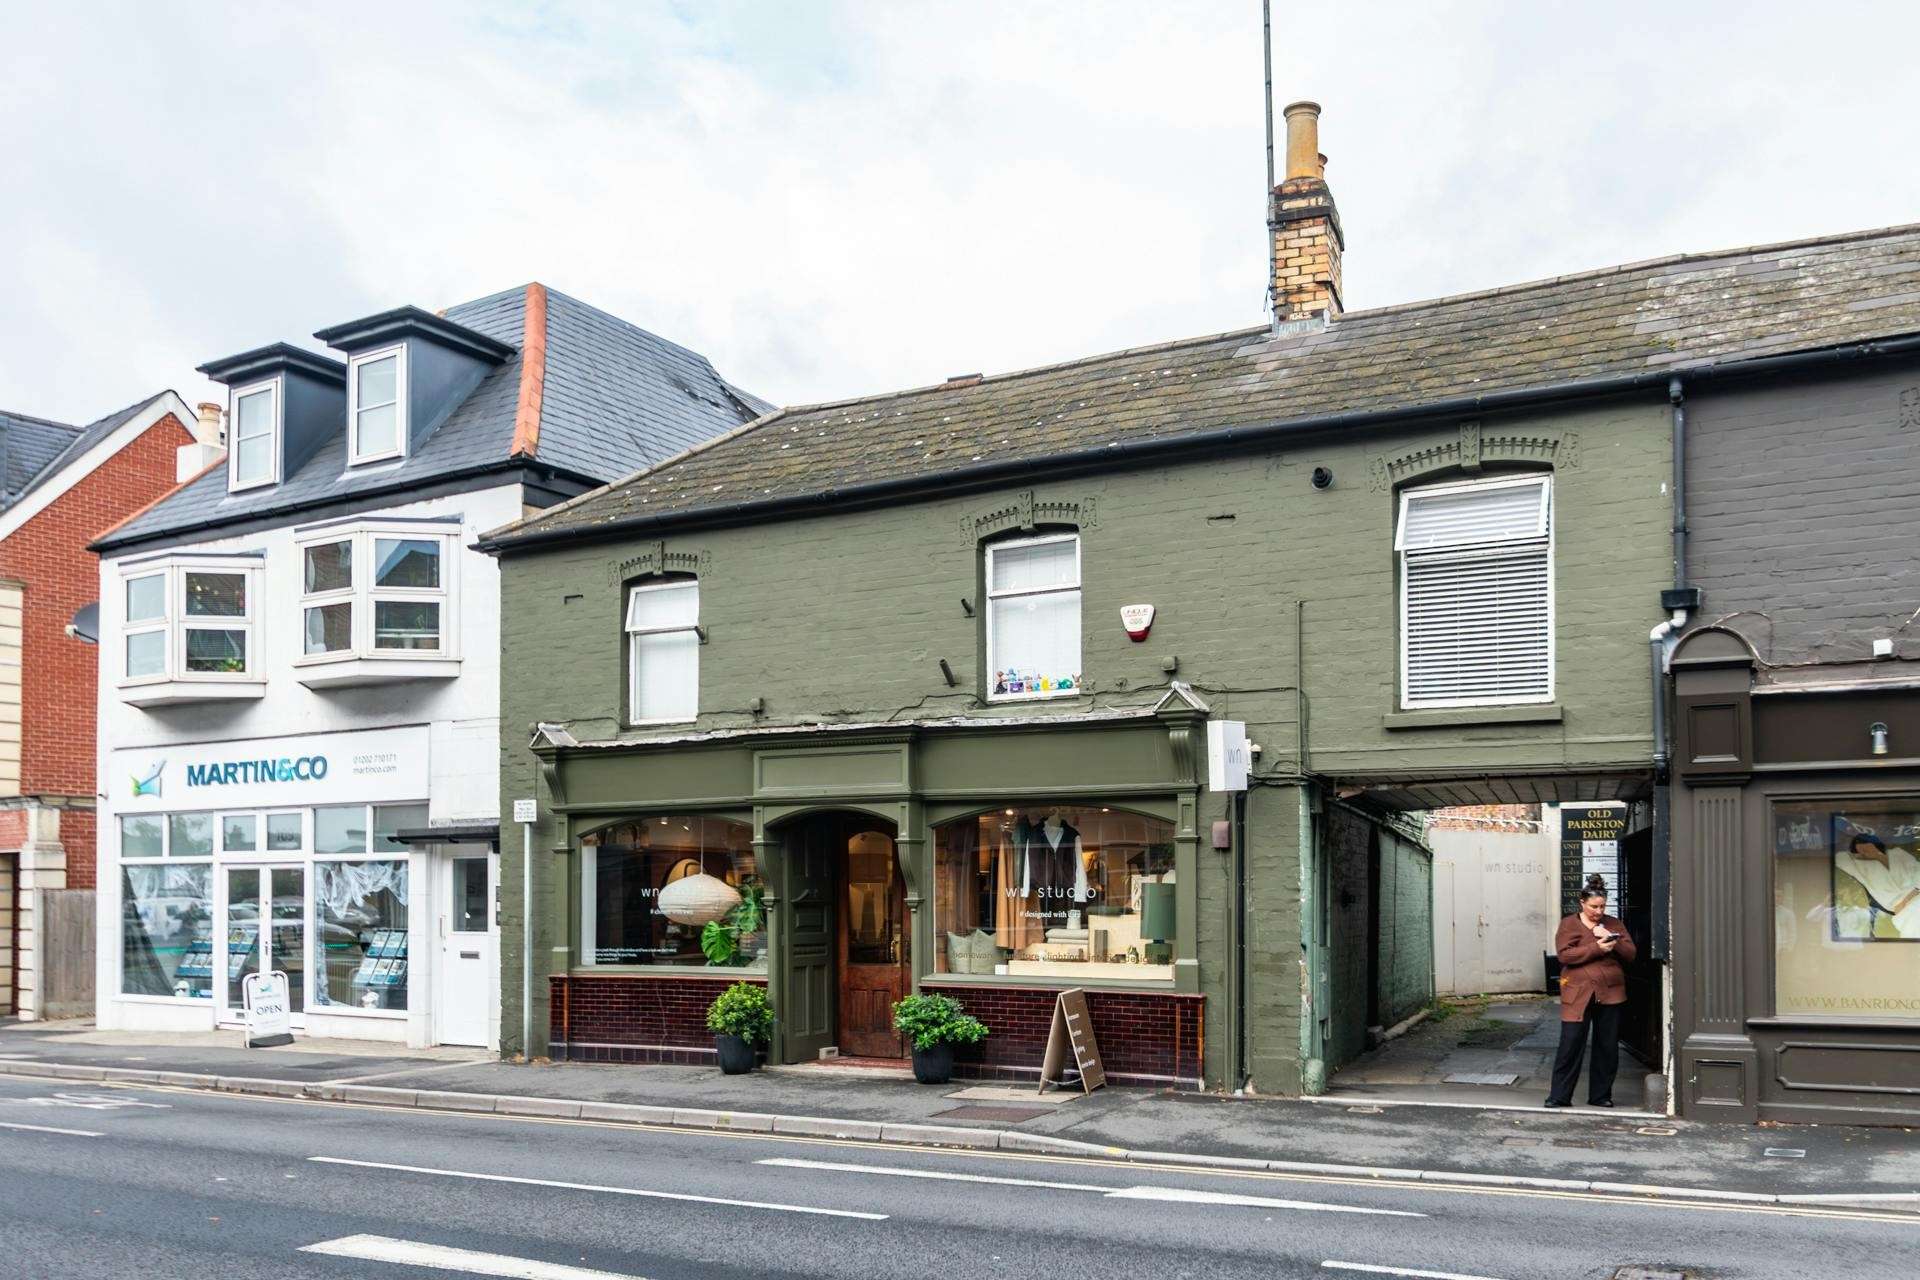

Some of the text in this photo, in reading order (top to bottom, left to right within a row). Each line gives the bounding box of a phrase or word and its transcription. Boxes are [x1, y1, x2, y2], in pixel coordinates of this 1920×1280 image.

[1226, 749, 1241, 764] wn
[187, 756, 328, 787] MARTIN&CO
[1588, 810, 1612, 818] OLD
[1583, 830, 1617, 839] DAIRY
[1504, 860, 1544, 874] studio
[1037, 885, 1097, 899] studo
[256, 1004, 282, 1015] OPEN
